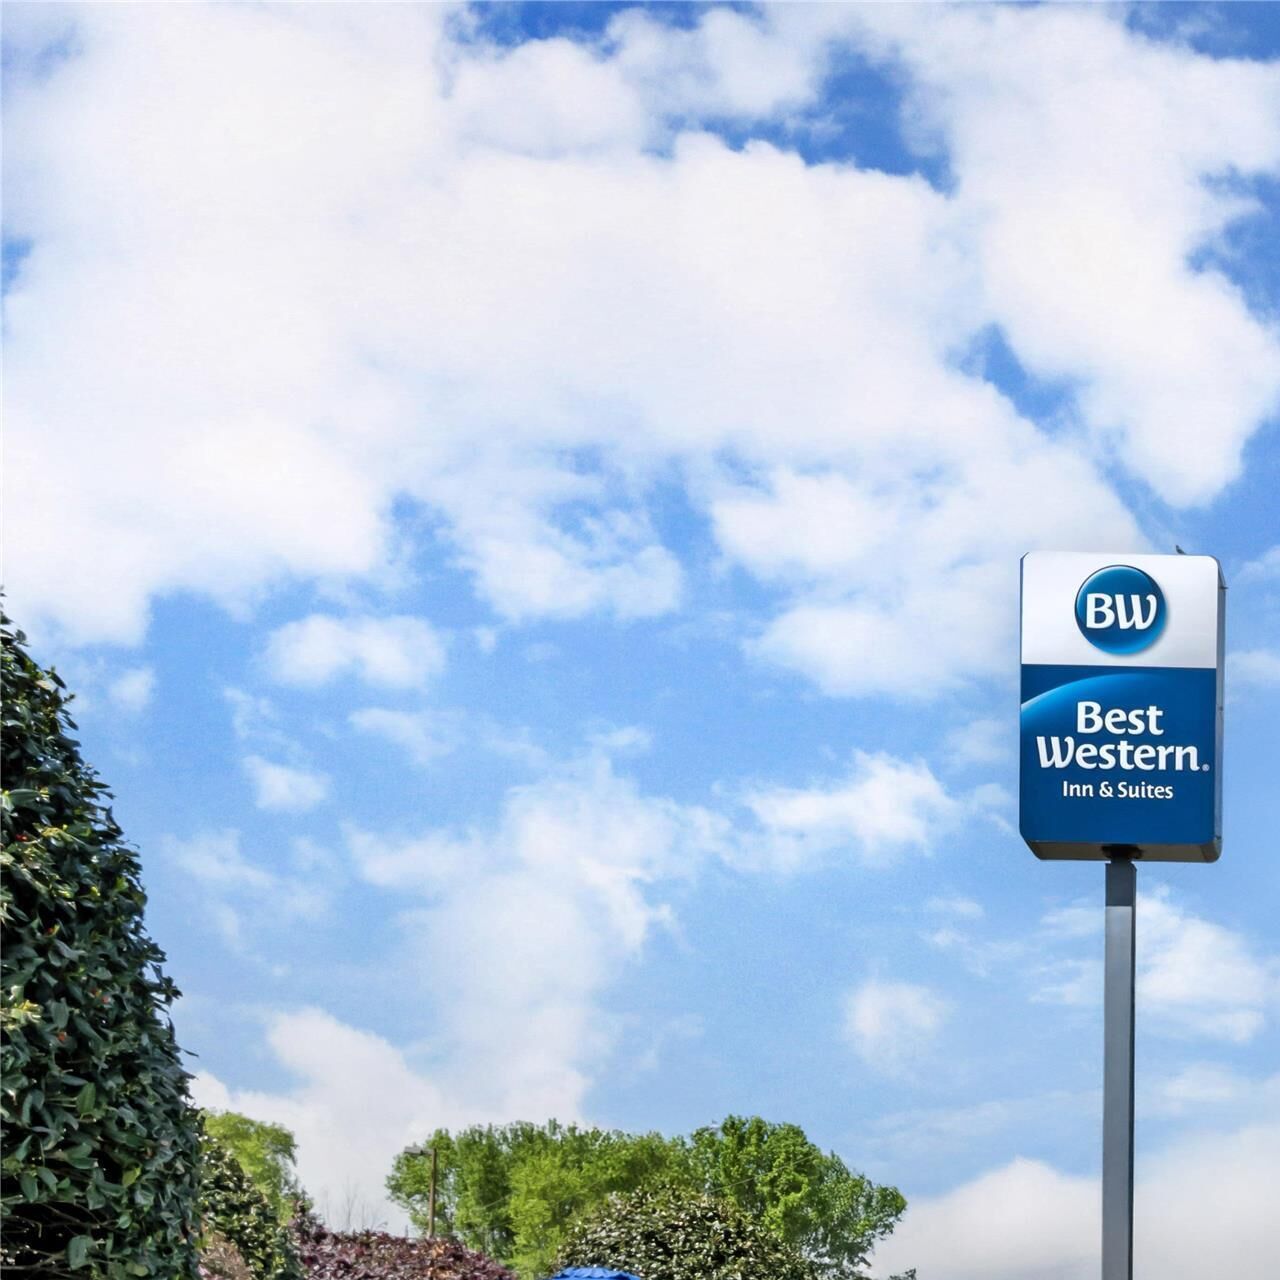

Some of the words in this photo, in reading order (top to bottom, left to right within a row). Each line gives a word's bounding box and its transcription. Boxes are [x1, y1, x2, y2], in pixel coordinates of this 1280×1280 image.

[1086, 592, 1158, 630] BW
[1077, 701, 1164, 736] Best
[1063, 780, 1094, 798] Inn
[1099, 781, 1114, 798] &
[1117, 781, 1174, 799] Suites
